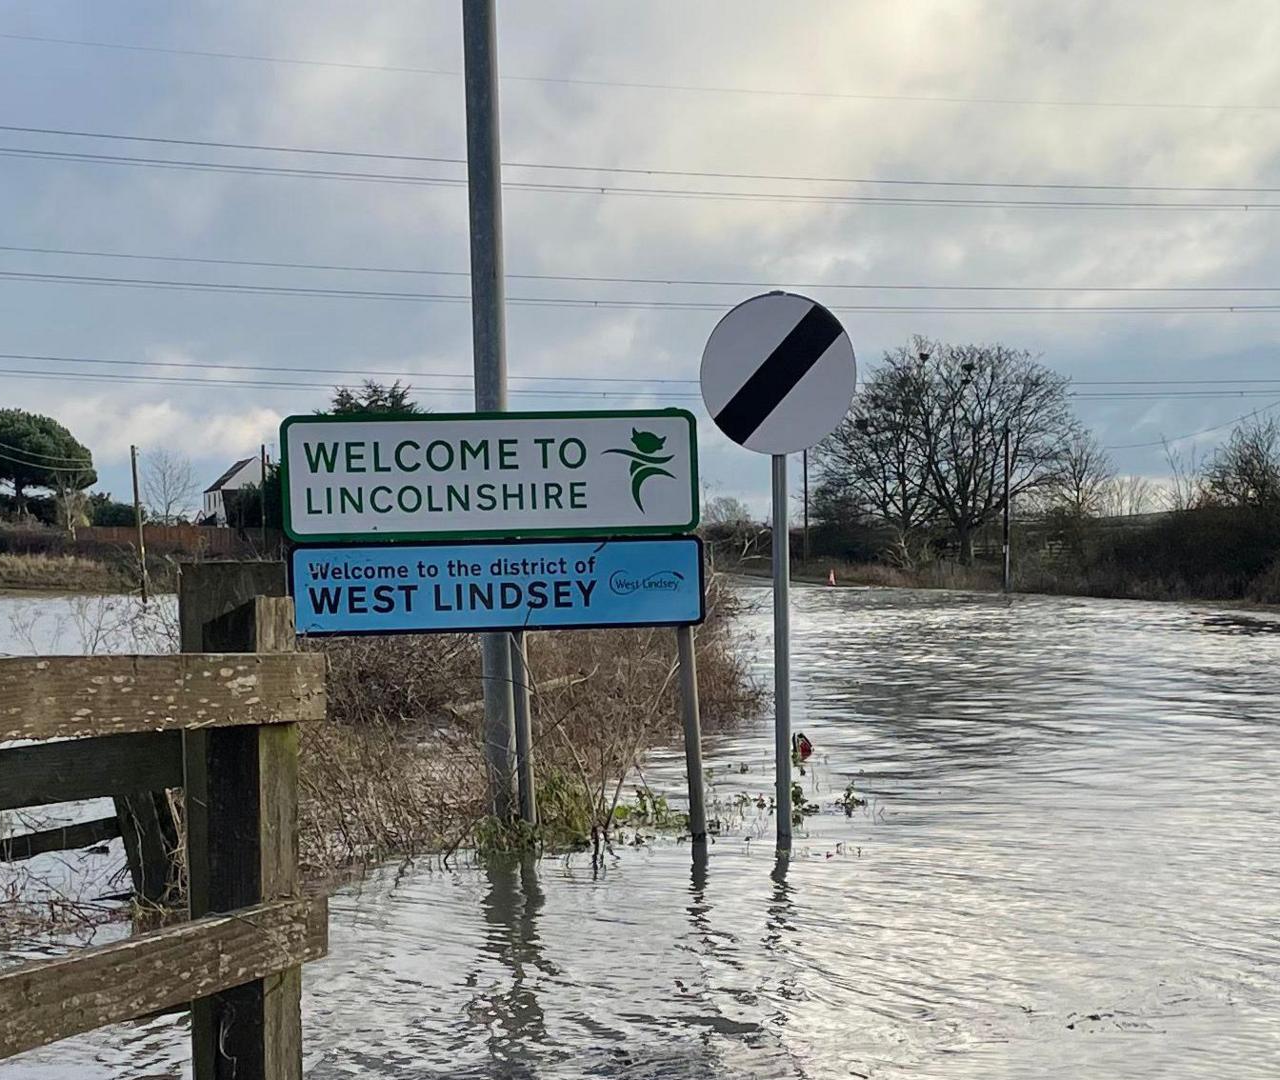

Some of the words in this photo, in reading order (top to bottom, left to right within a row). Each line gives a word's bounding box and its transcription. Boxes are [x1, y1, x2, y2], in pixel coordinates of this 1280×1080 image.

[303, 439, 519, 474] WELCOME
[534, 437, 587, 470] TO
[306, 481, 588, 515] LINCOLNSHIRE
[308, 561, 409, 581] Welcome
[418, 560, 438, 578] to
[447, 558, 481, 577] the
[490, 556, 568, 576] district
[574, 555, 596, 574] of
[615, 579, 640, 590] West
[642, 578, 679, 591] Lindsey
[308, 584, 418, 614] WEST
[434, 579, 597, 612] LINDSEY
